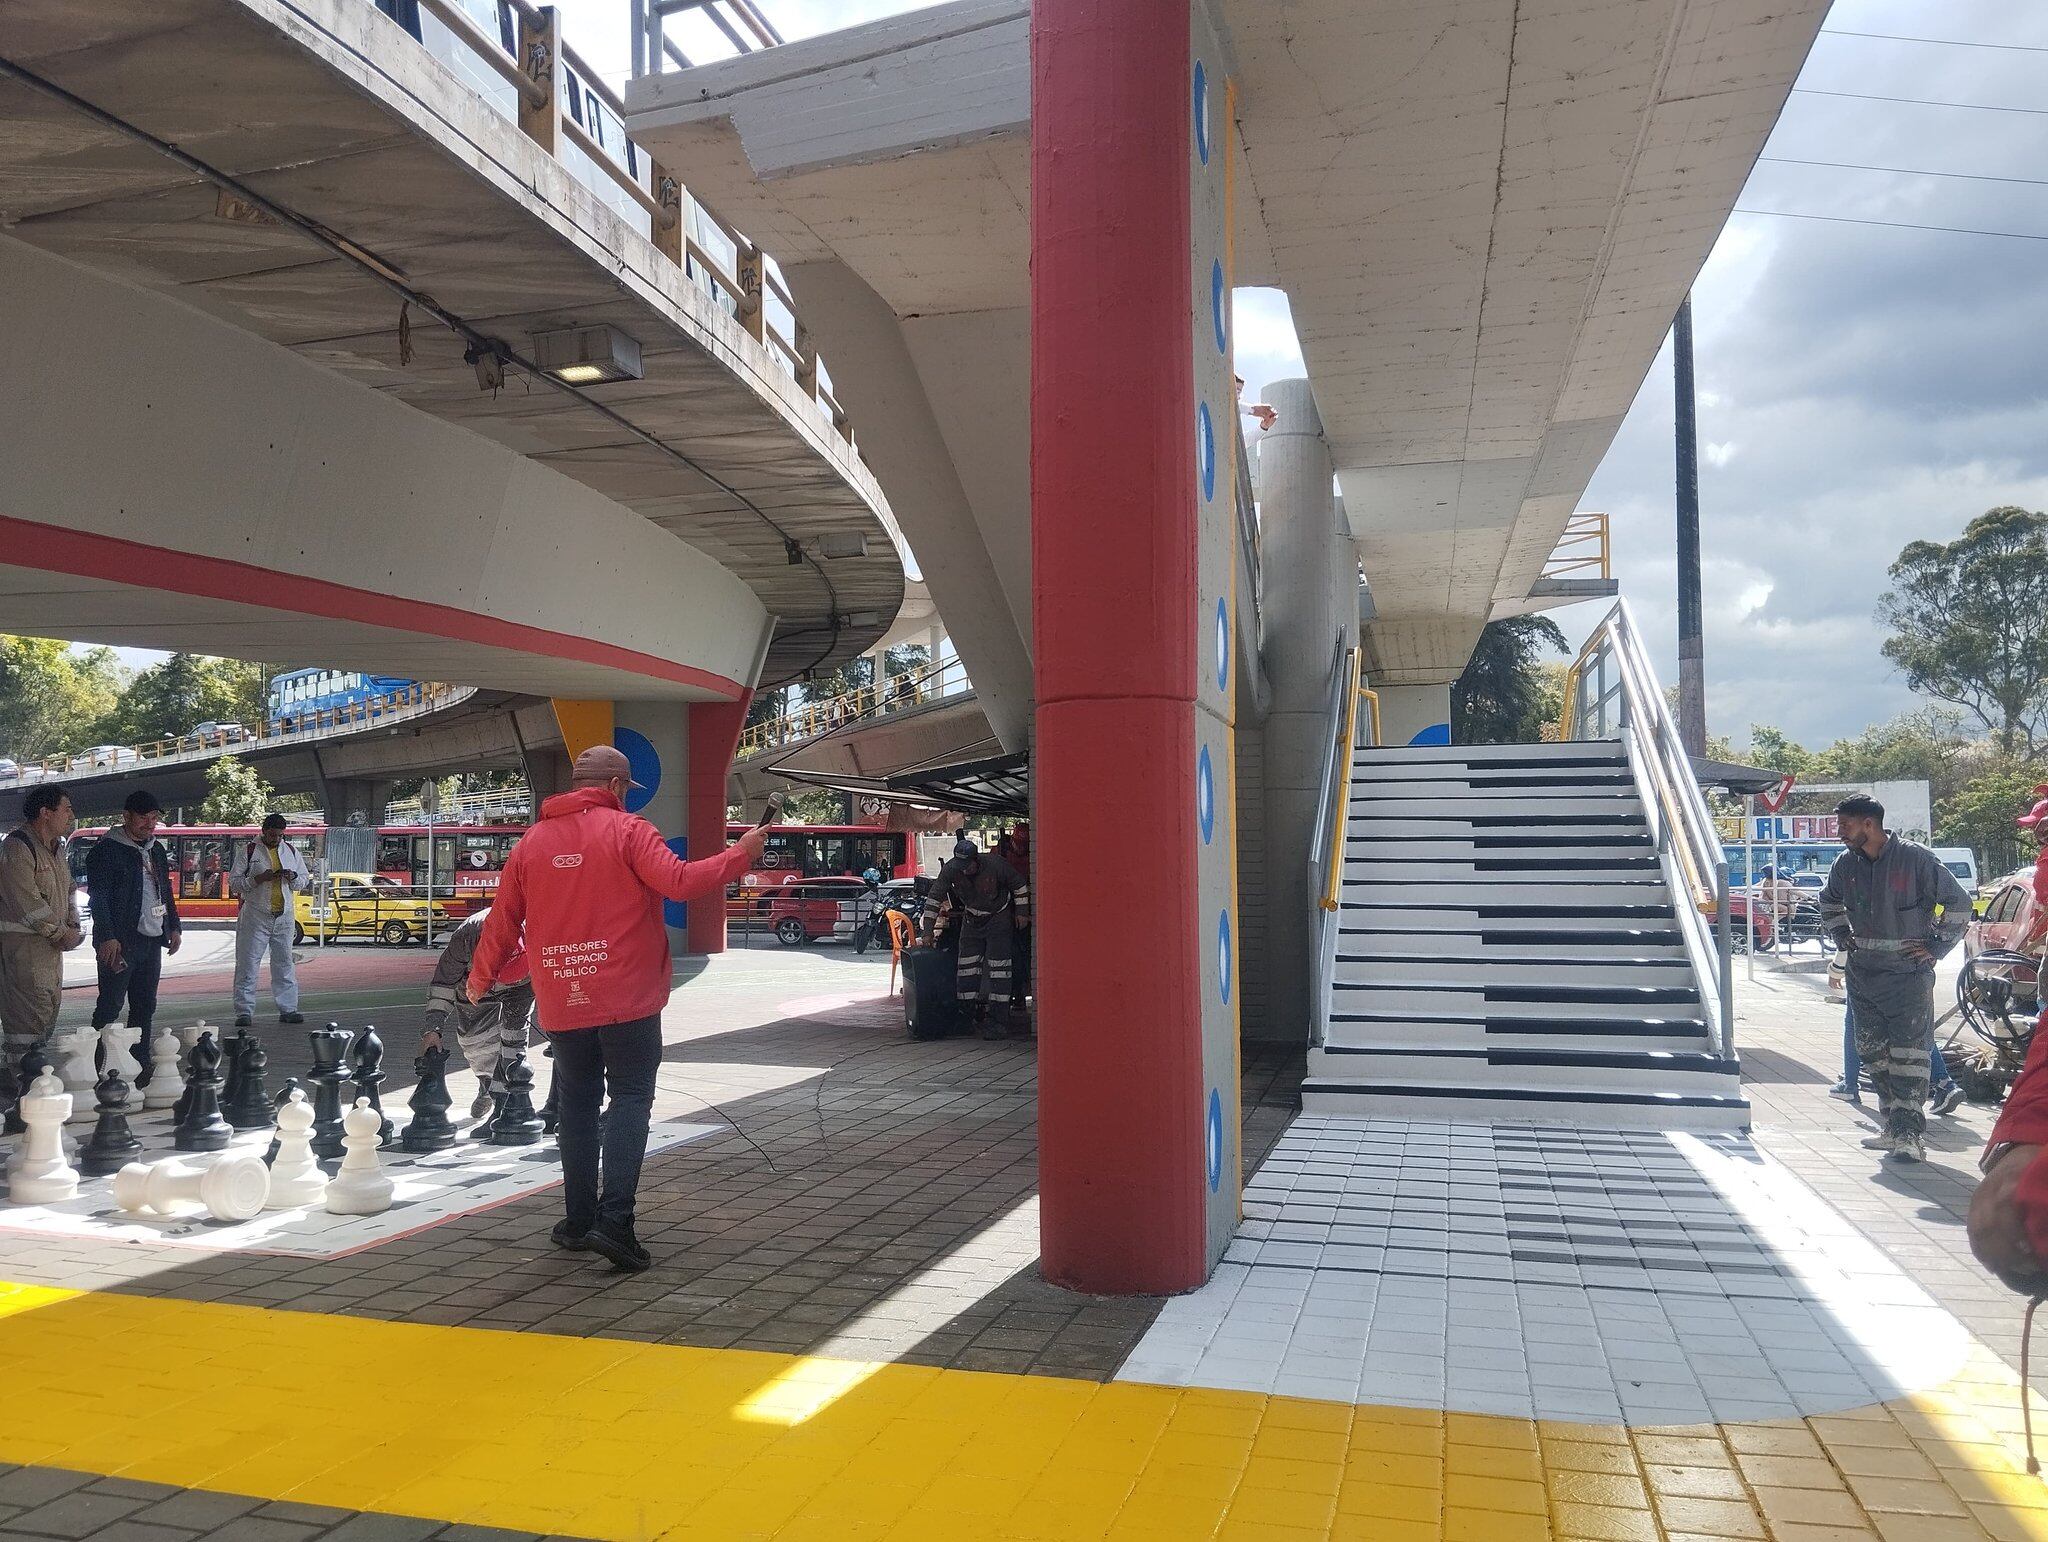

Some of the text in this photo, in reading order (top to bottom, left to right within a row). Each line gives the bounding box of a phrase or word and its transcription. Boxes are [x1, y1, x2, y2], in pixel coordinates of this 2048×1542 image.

[1756, 817, 1789, 839] AL
[542, 939, 608, 956] DEFENSORES
[542, 952, 608, 968] DEL ESPACIO
[553, 965, 597, 979] PÚBLICO
